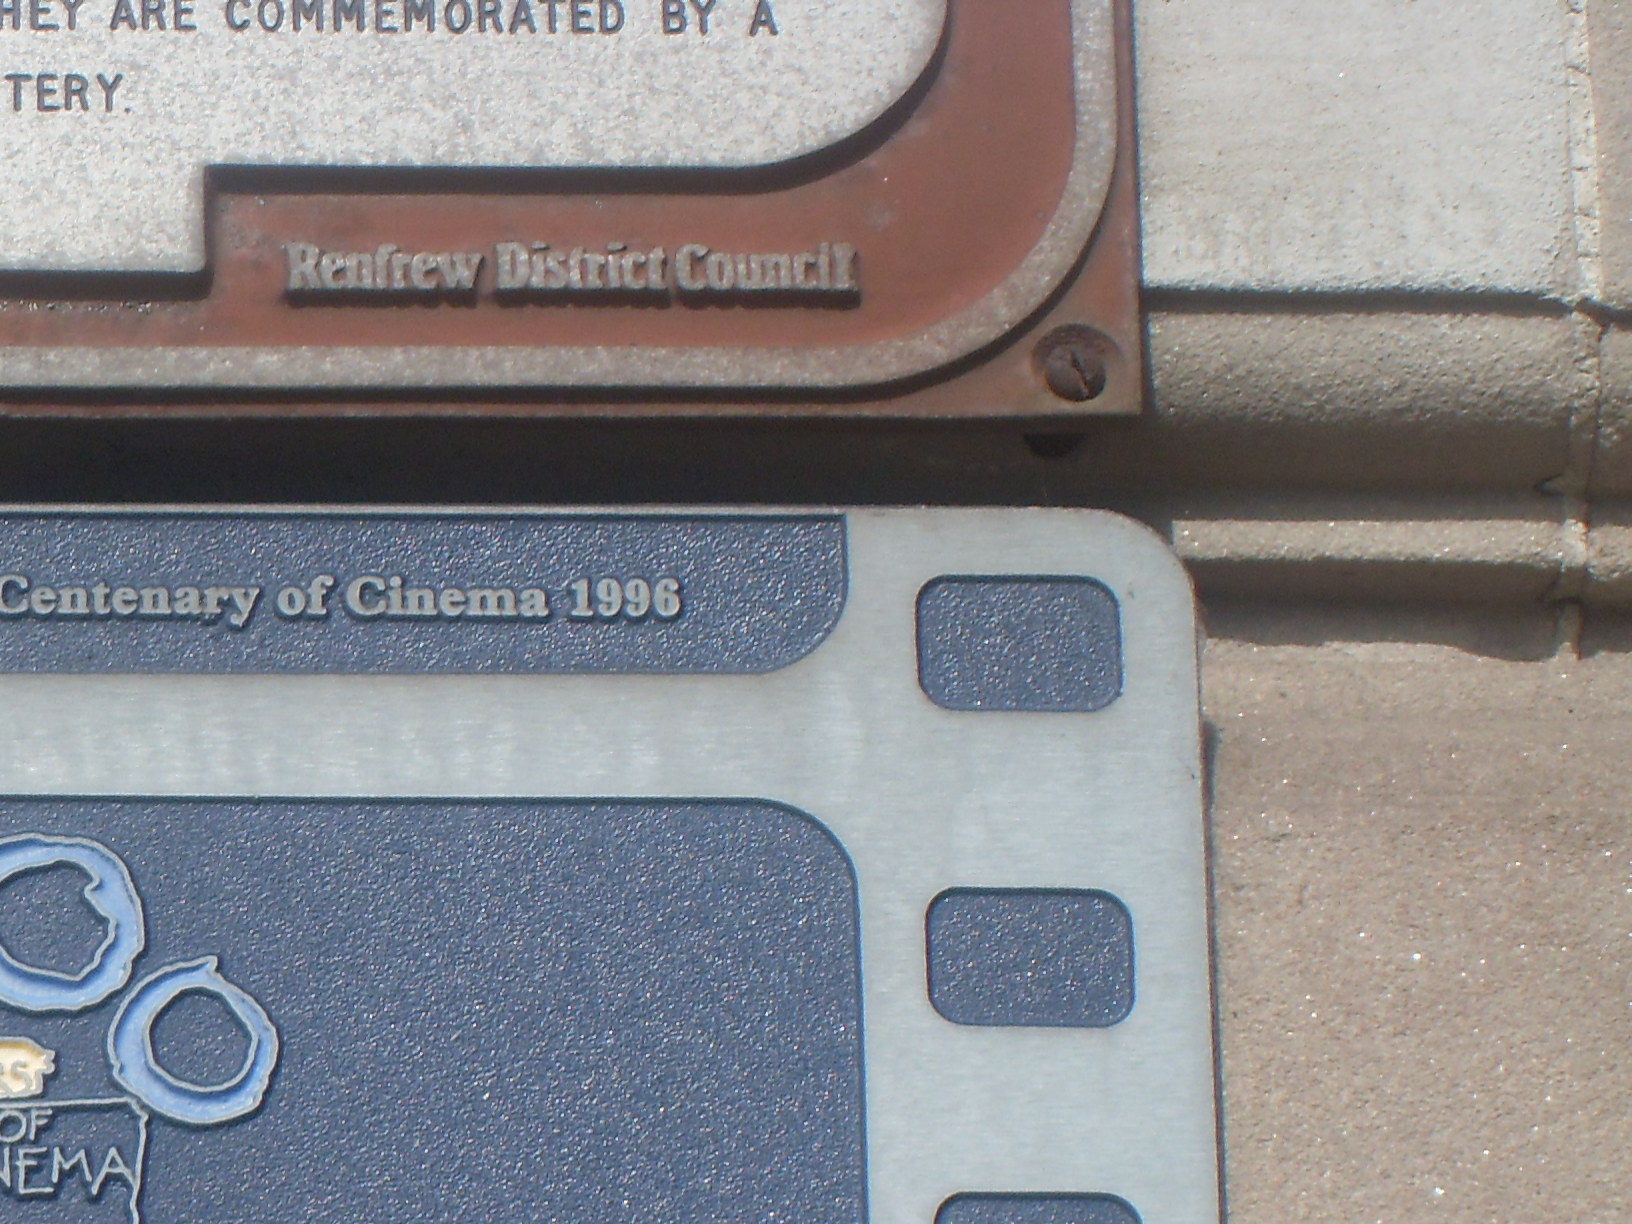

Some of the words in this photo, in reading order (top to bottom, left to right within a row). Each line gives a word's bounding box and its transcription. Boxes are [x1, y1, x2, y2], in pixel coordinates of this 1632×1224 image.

[109, 0, 197, 32] ARE
[225, 0, 626, 34] COMMEMORATED
[663, 0, 718, 35] BY
[749, 0, 781, 35] A
[282, 241, 485, 291] Renfrew
[494, 241, 667, 291] District
[674, 242, 858, 292] Council
[276, 574, 335, 616] of
[347, 576, 549, 617] Cinema
[570, 577, 681, 618] 1996
